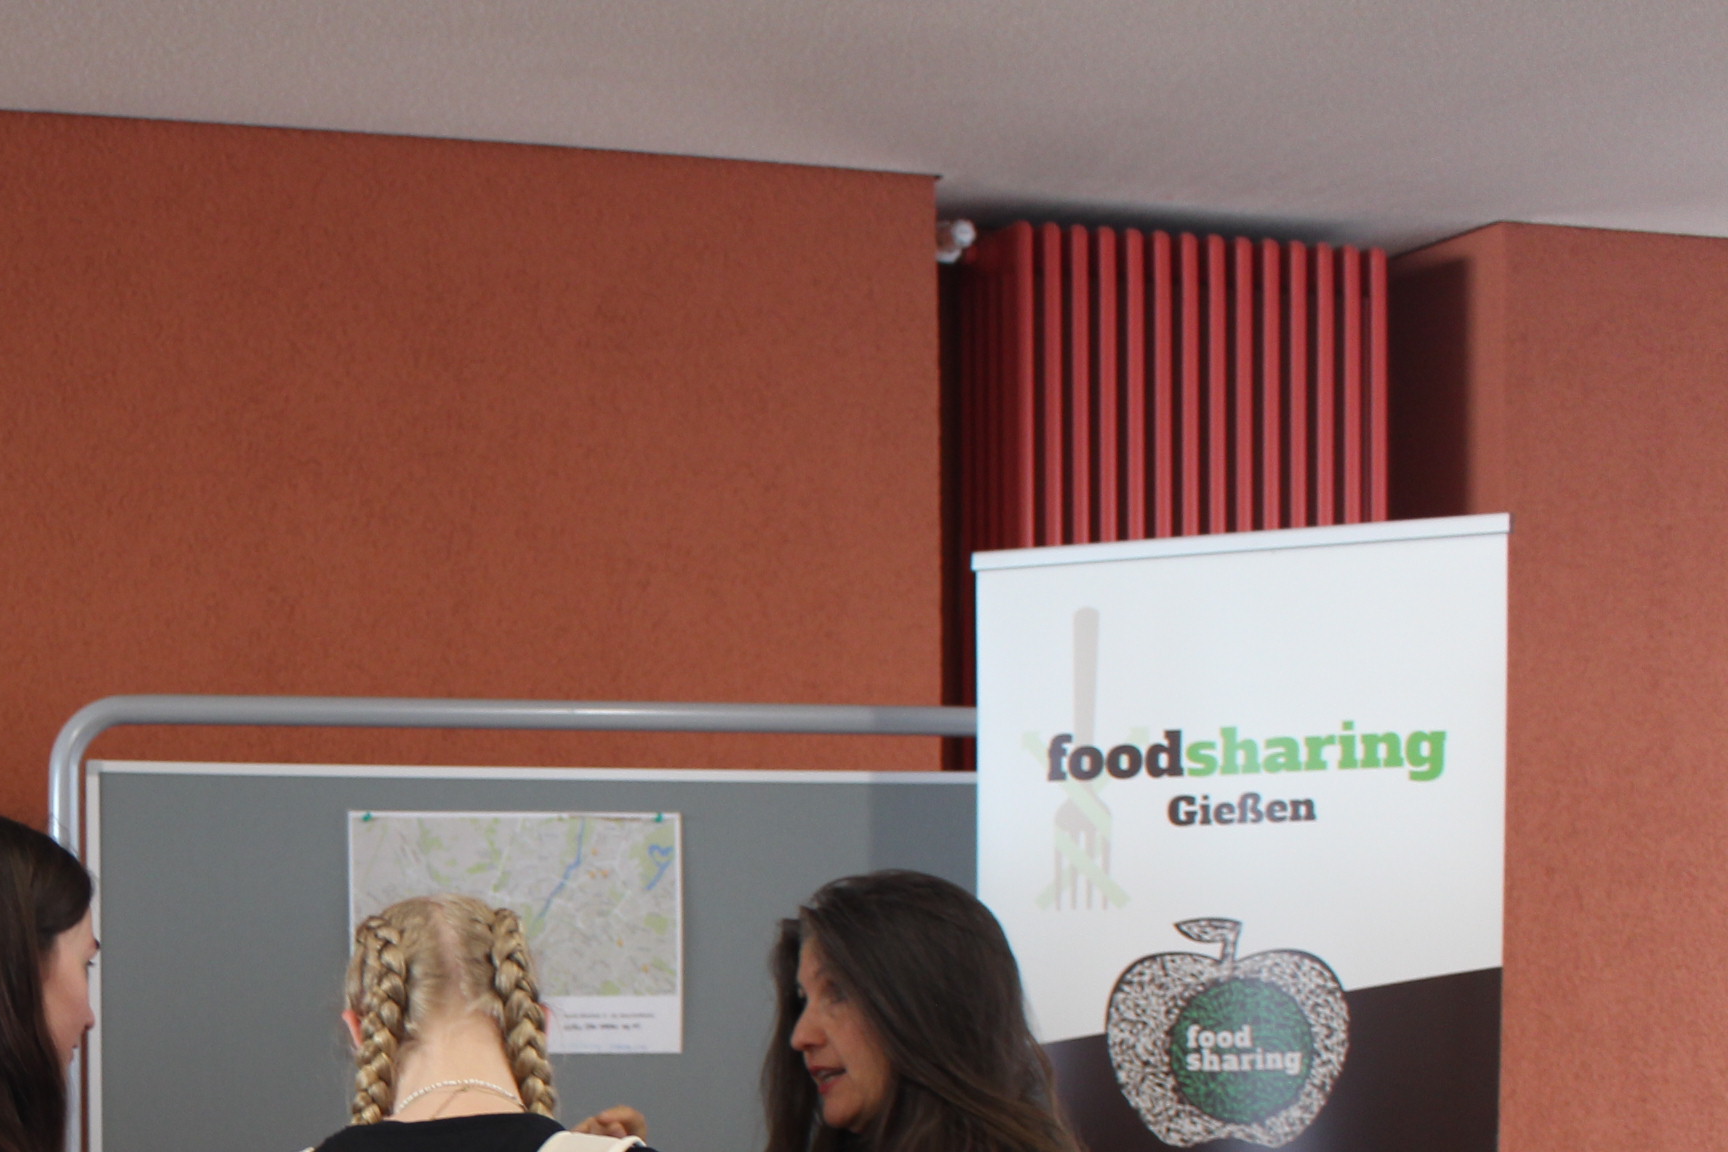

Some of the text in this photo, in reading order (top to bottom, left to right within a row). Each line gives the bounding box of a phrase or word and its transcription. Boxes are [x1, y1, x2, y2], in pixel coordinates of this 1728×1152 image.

[1047, 720, 1446, 781] foodsharing
[1167, 792, 1317, 826] Gießen
[1186, 1024, 1252, 1048] food
[1186, 1049, 1303, 1074] sharing
